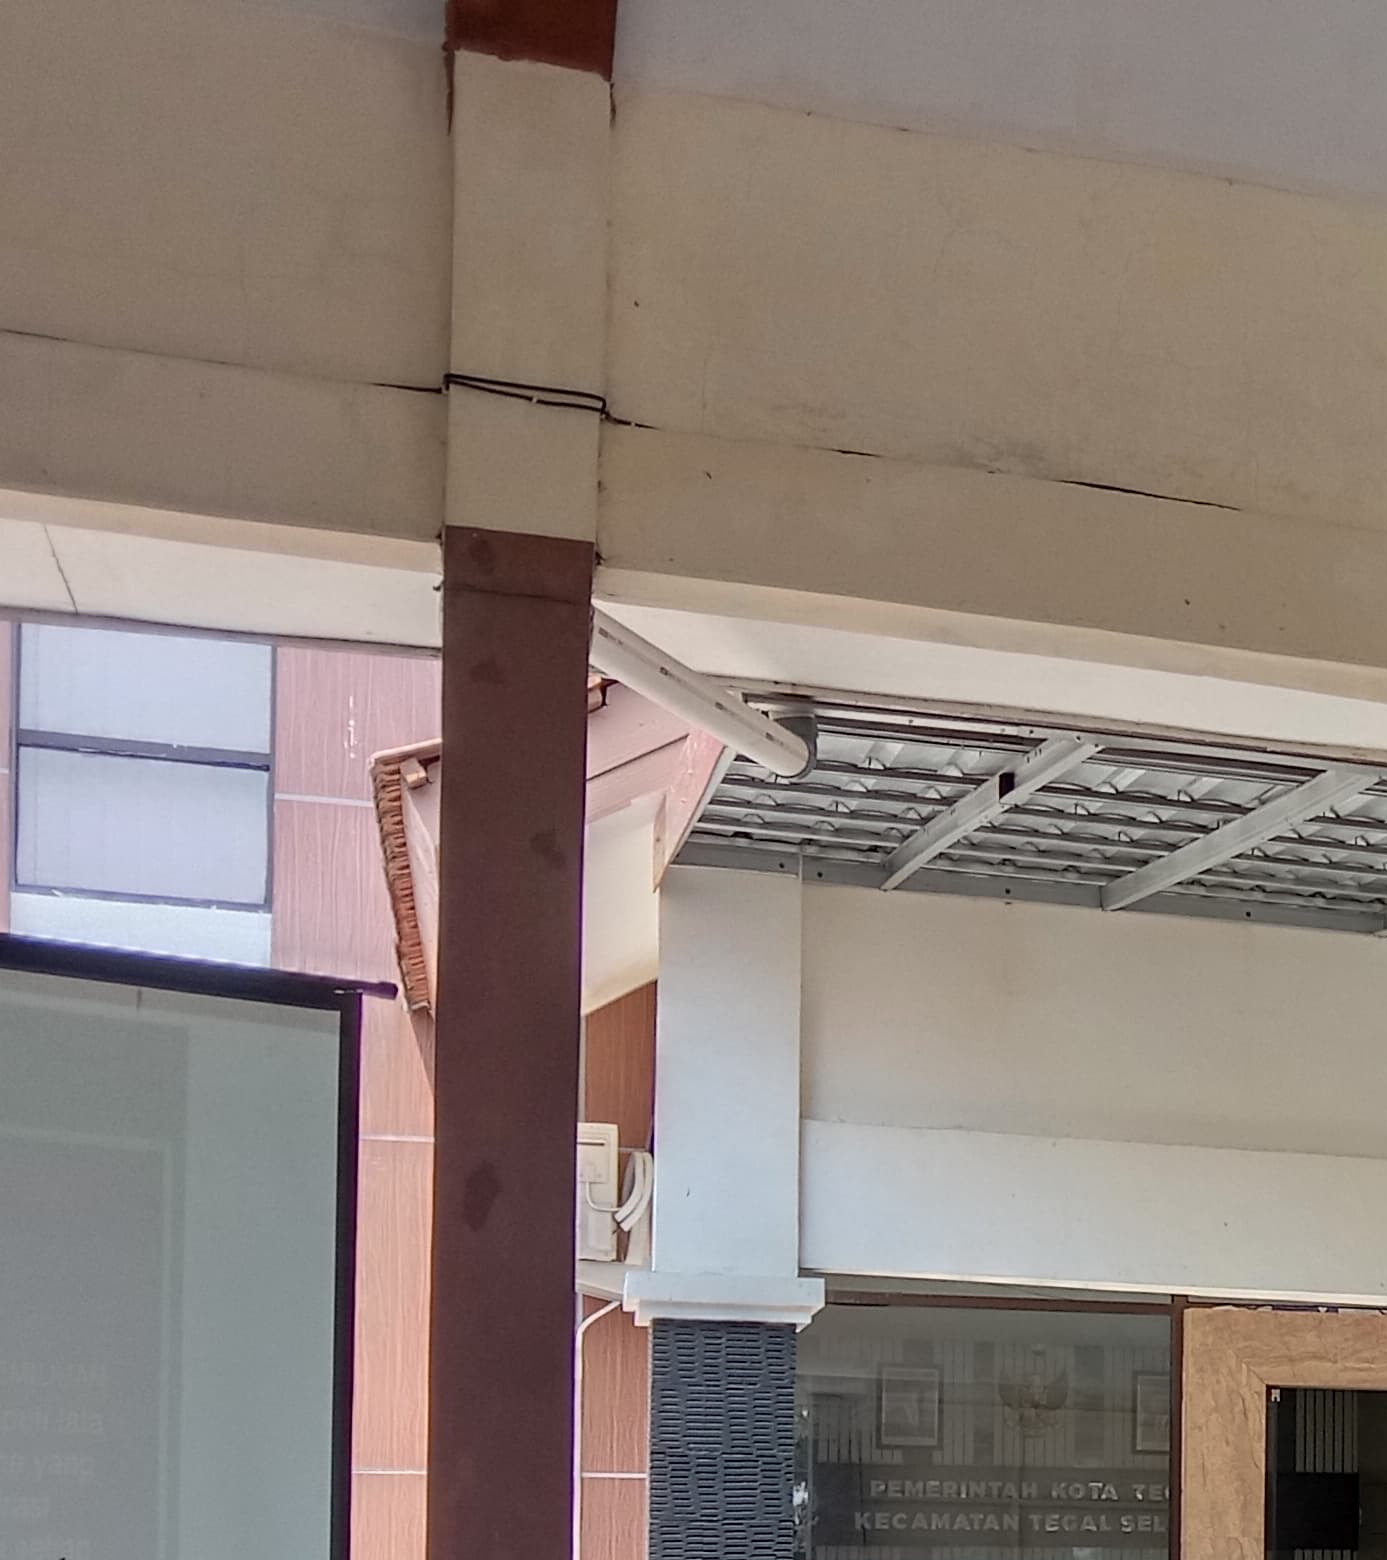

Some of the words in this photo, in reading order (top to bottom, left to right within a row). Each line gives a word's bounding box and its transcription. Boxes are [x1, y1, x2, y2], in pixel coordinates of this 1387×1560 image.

[869, 1479, 1038, 1499] PEMERINTAH
[1051, 1481, 1118, 1500] KOTA
[854, 1511, 1020, 1532] KECAMATAN
[1028, 1512, 1112, 1533] TEGAL
